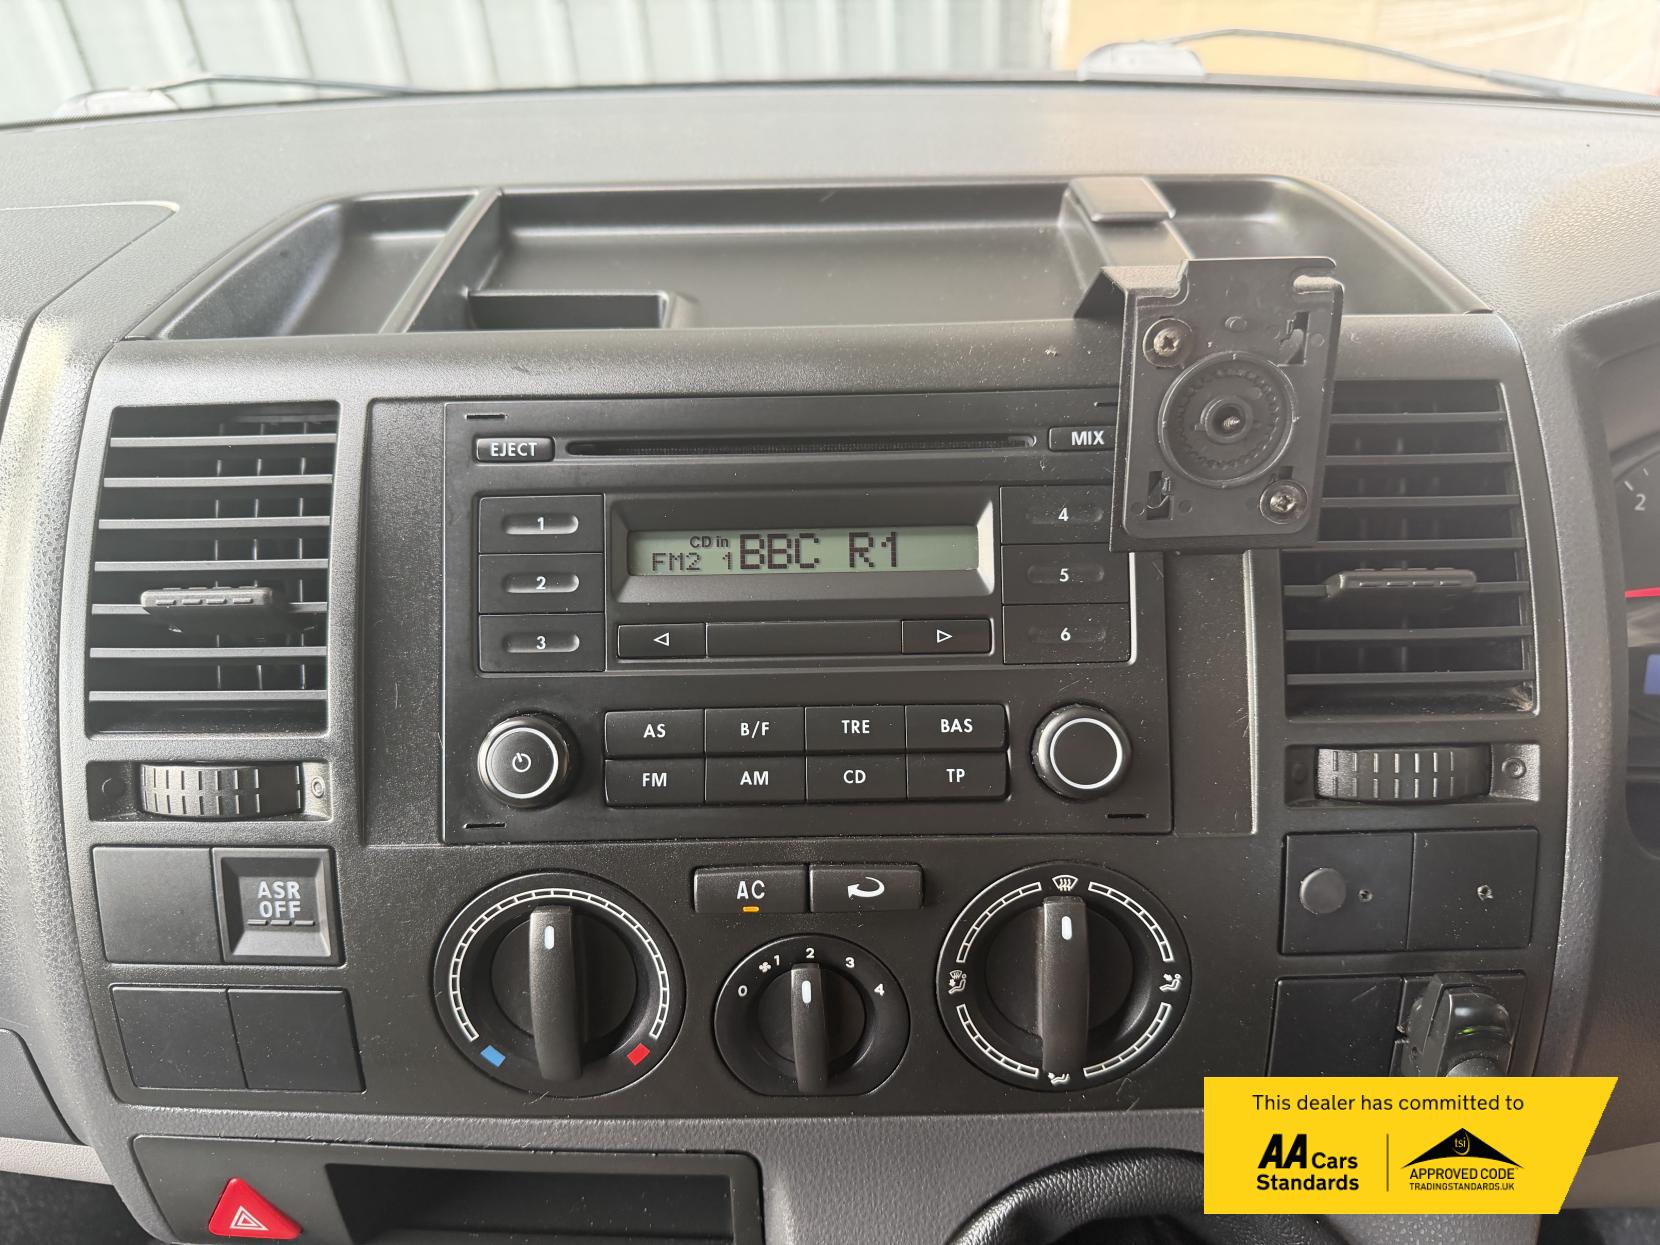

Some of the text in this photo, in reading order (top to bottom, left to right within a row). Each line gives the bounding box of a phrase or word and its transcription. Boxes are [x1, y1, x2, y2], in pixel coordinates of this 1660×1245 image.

[1070, 430, 1105, 447] MIX
[490, 442, 538, 458] EJECT
[1634, 493, 1647, 512] 2
[1057, 507, 1069, 523] 4
[536, 516, 545, 531] 1
[689, 534, 729, 549] CD in
[739, 530, 898, 570] BBC R1
[652, 551, 733, 572] FM2 1
[1059, 567, 1070, 583] 5
[535, 576, 547, 591] 2
[1060, 627, 1072, 642] 6
[535, 635, 547, 651] 3
[643, 723, 666, 739] AS
[740, 720, 770, 738] B/F
[841, 719, 871, 735] TRE
[940, 718, 974, 734] BAS
[642, 772, 668, 788] FM
[739, 770, 769, 787] AM
[843, 769, 867, 785] CD
[946, 768, 966, 784] TP
[257, 880, 301, 899] ASR
[736, 879, 766, 900] AC
[259, 901, 301, 918] OFF
[773, 954, 780, 967] 1
[805, 947, 815, 959] 2
[845, 956, 855, 969] 3
[873, 983, 885, 997] 4
